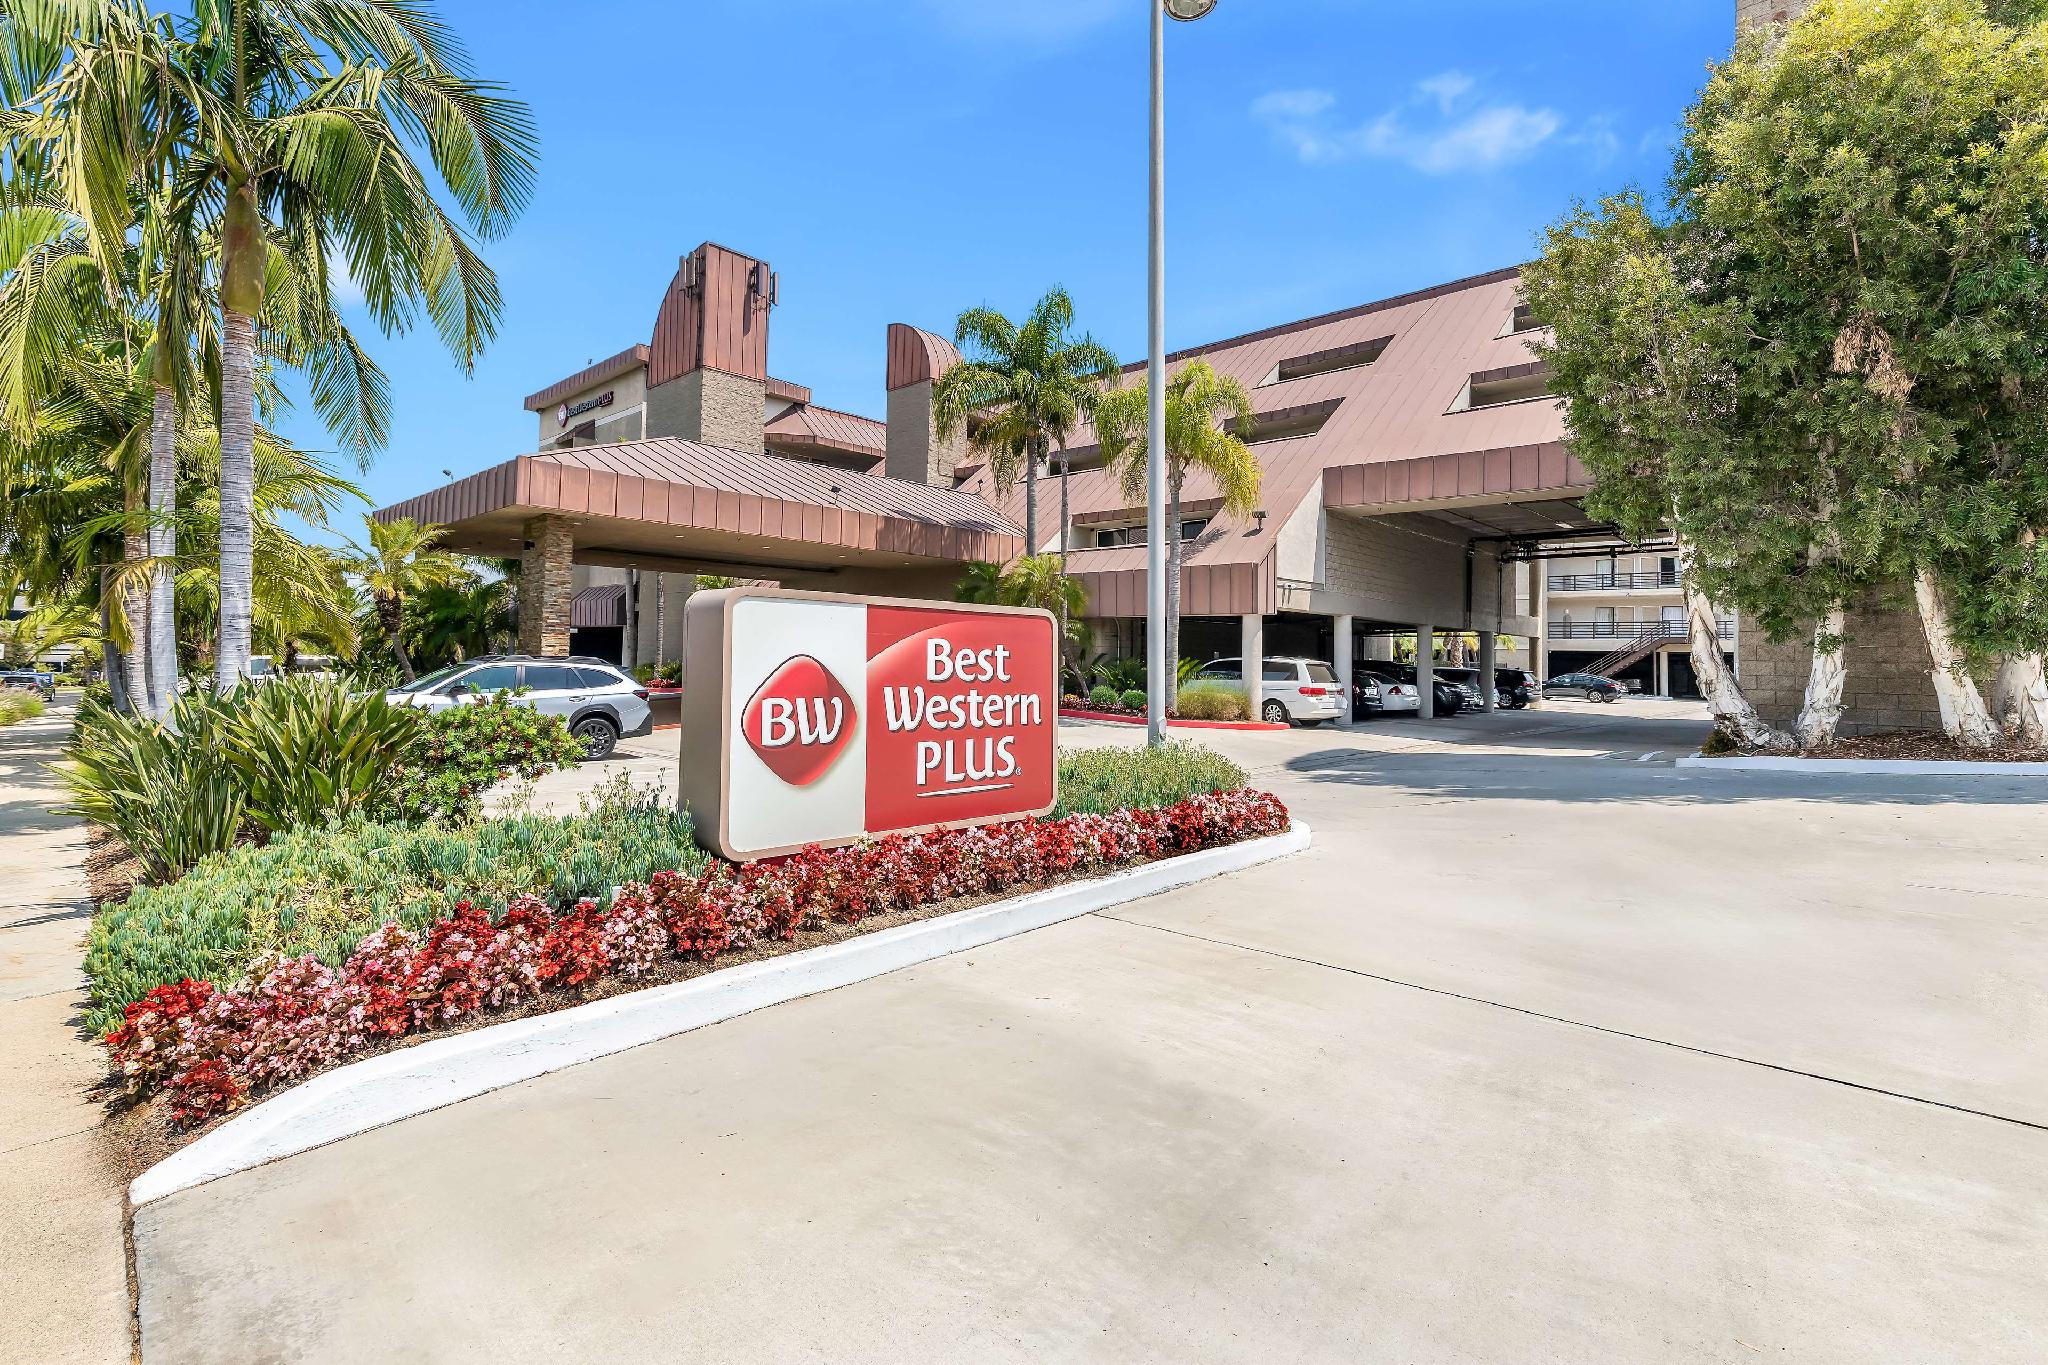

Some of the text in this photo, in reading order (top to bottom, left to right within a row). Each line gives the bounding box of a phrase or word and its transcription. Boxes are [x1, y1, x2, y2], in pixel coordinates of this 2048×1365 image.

[926, 638, 1011, 682] Best
[761, 696, 843, 747] BW
[883, 685, 1042, 732] Western
